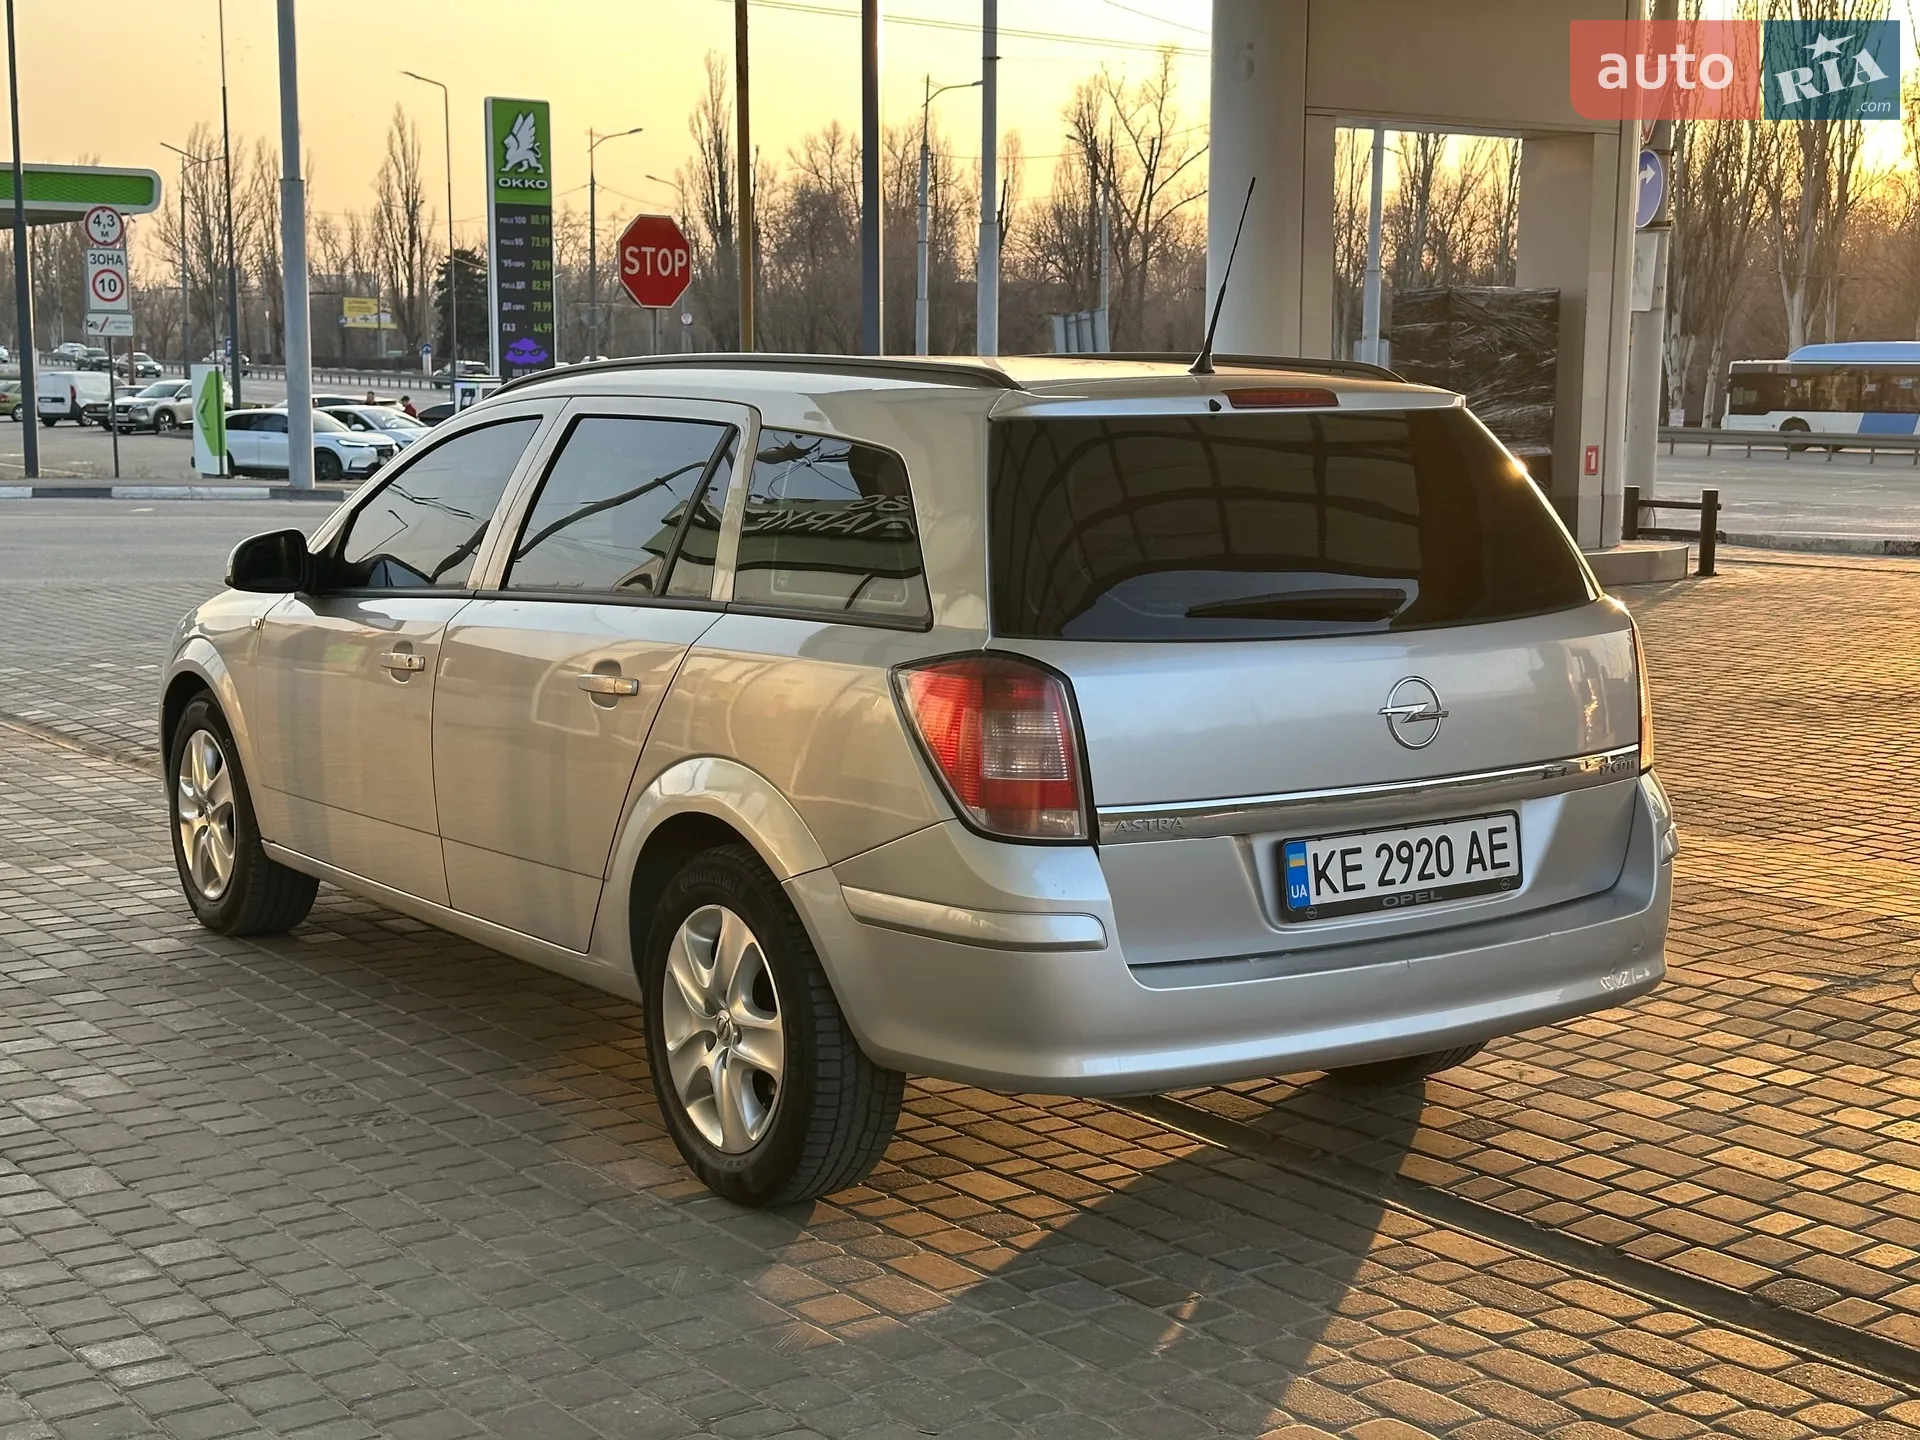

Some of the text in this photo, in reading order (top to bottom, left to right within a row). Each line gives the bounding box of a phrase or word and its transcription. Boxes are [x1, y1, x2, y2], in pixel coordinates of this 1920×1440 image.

[498, 177, 549, 189] OKKO
[92, 213, 116, 229] 4,3
[514, 238, 523, 246] 95
[89, 253, 124, 266] ЗОНА
[623, 246, 688, 277] STOP
[98, 278, 117, 293] 10
[502, 323, 516, 332] ГАЗ
[1114, 817, 1186, 833] ASTRA
[1312, 826, 1510, 896] KE 2920 AE
[1291, 884, 1308, 898] UA
[1382, 890, 1442, 907] OPEL
